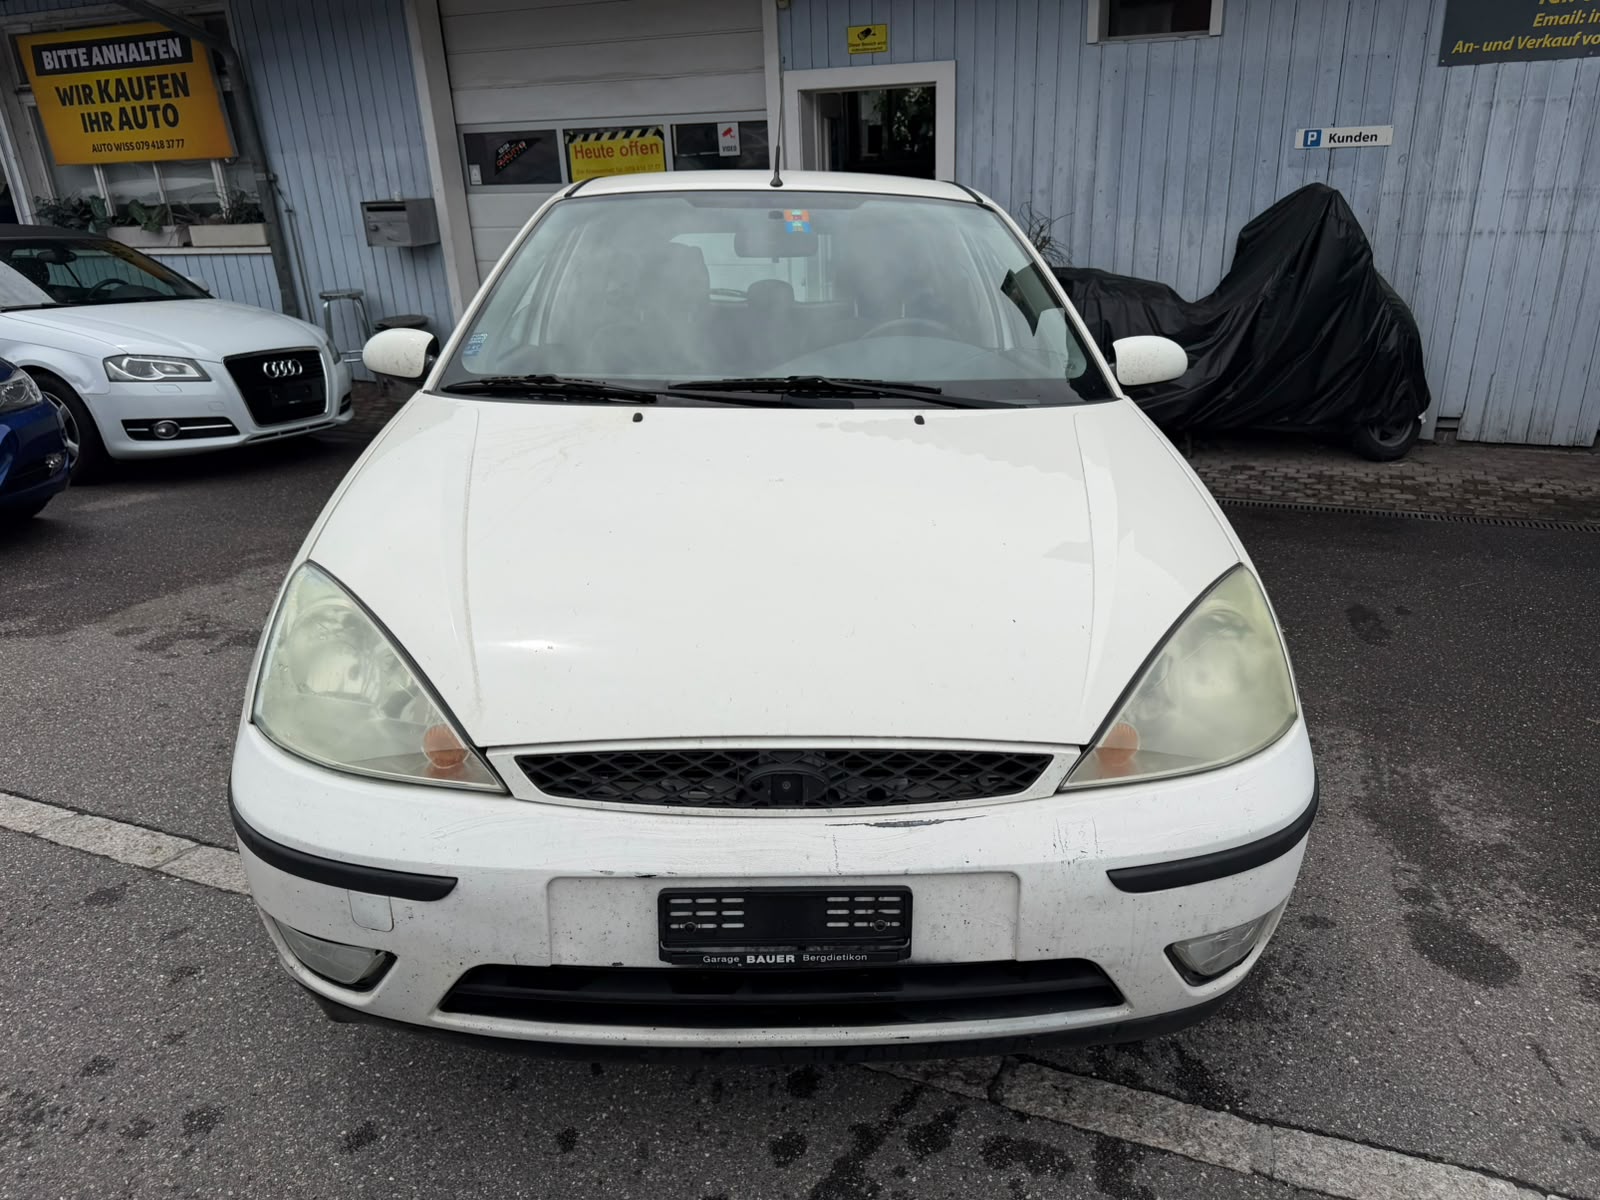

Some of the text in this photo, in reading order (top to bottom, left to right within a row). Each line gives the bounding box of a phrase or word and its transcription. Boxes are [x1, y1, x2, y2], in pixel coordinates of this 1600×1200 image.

[1533, 9, 1586, 28] Email:
[1451, 40, 1480, 54] An-
[1482, 36, 1515, 52] und
[1517, 32, 1582, 50] Verkauf
[42, 37, 183, 70] BITTE ANHALTEN
[55, 72, 190, 107] WIR KAUFEN
[81, 103, 179, 133] IHR AUTO
[92, 138, 184, 153] AUTO WISS 079 418 37 77
[1329, 132, 1378, 143] Kunden
[574, 140, 660, 160] Heute offen
[702, 953, 868, 964] Garage BAUER Bergdietikon
